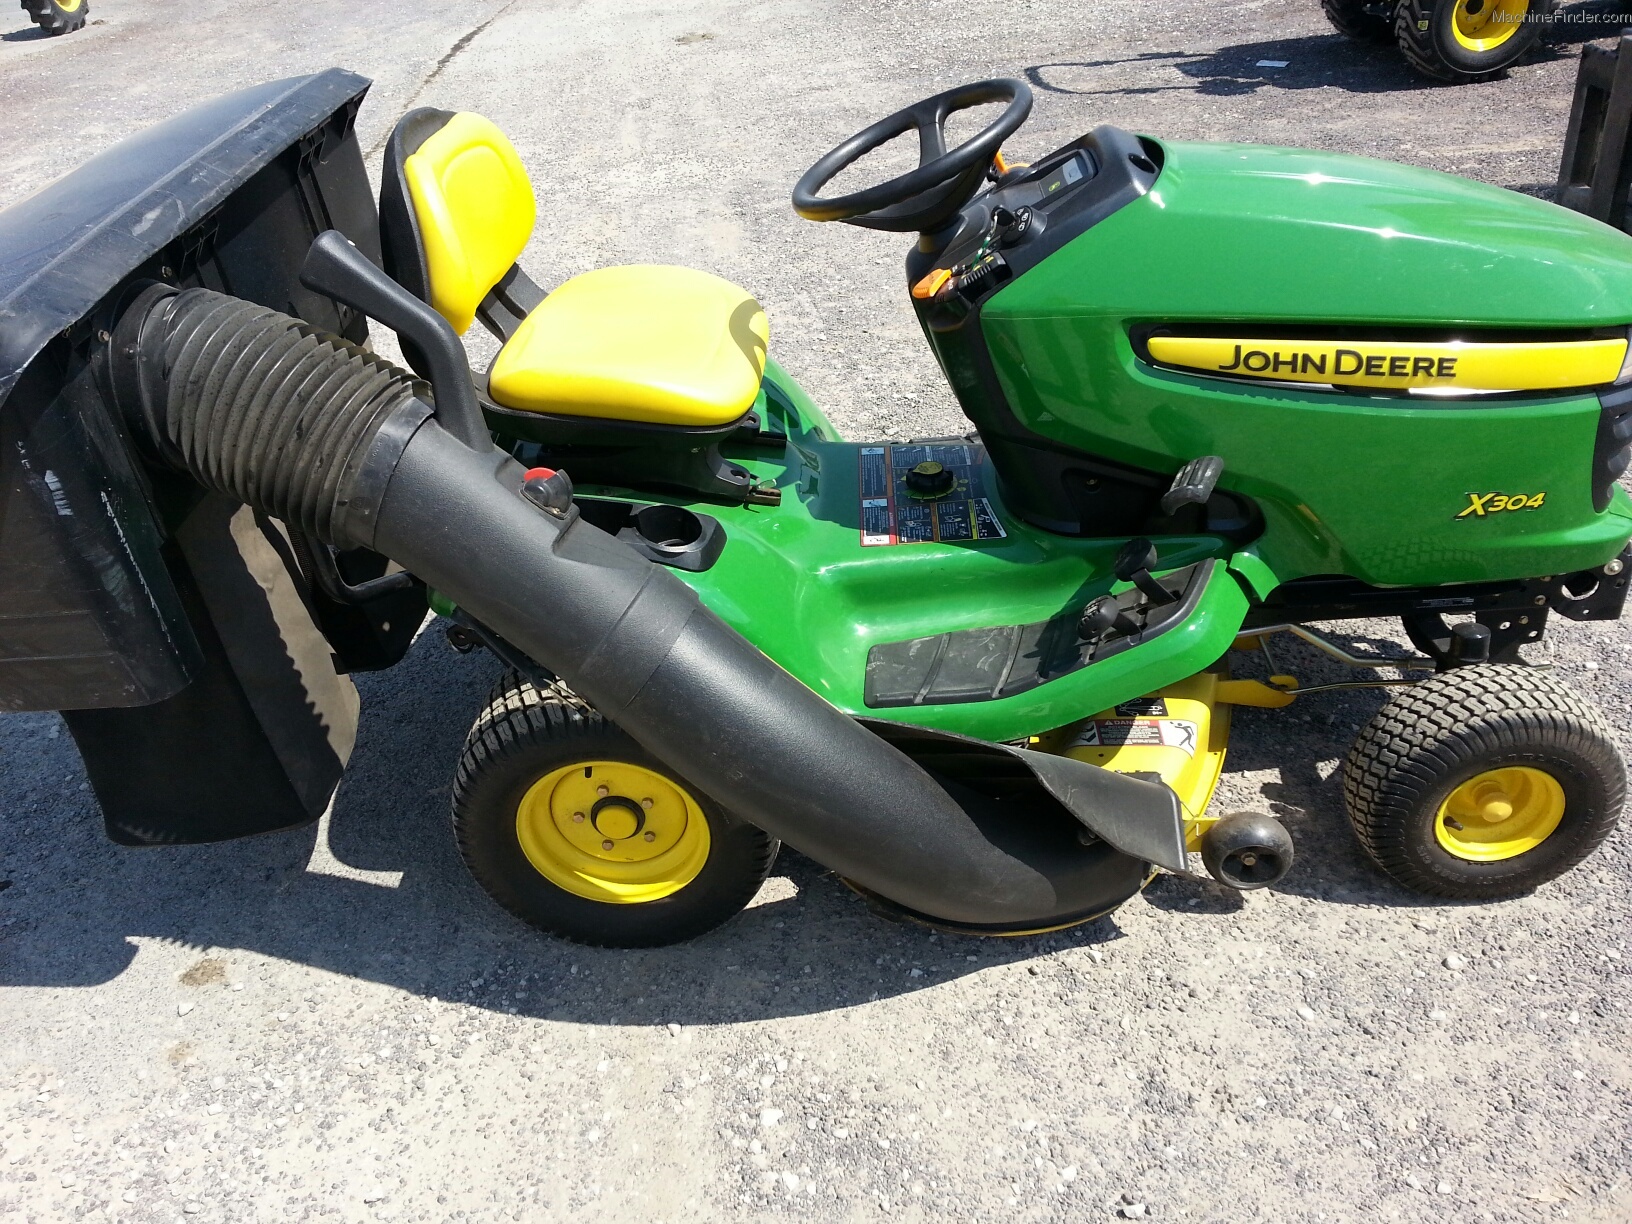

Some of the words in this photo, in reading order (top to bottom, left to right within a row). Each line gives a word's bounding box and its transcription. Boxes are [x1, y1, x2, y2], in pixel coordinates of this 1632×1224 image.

[1218, 344, 1327, 375] JOHN
[1334, 348, 1458, 378] DEERE
[1456, 491, 1546, 517] X304
